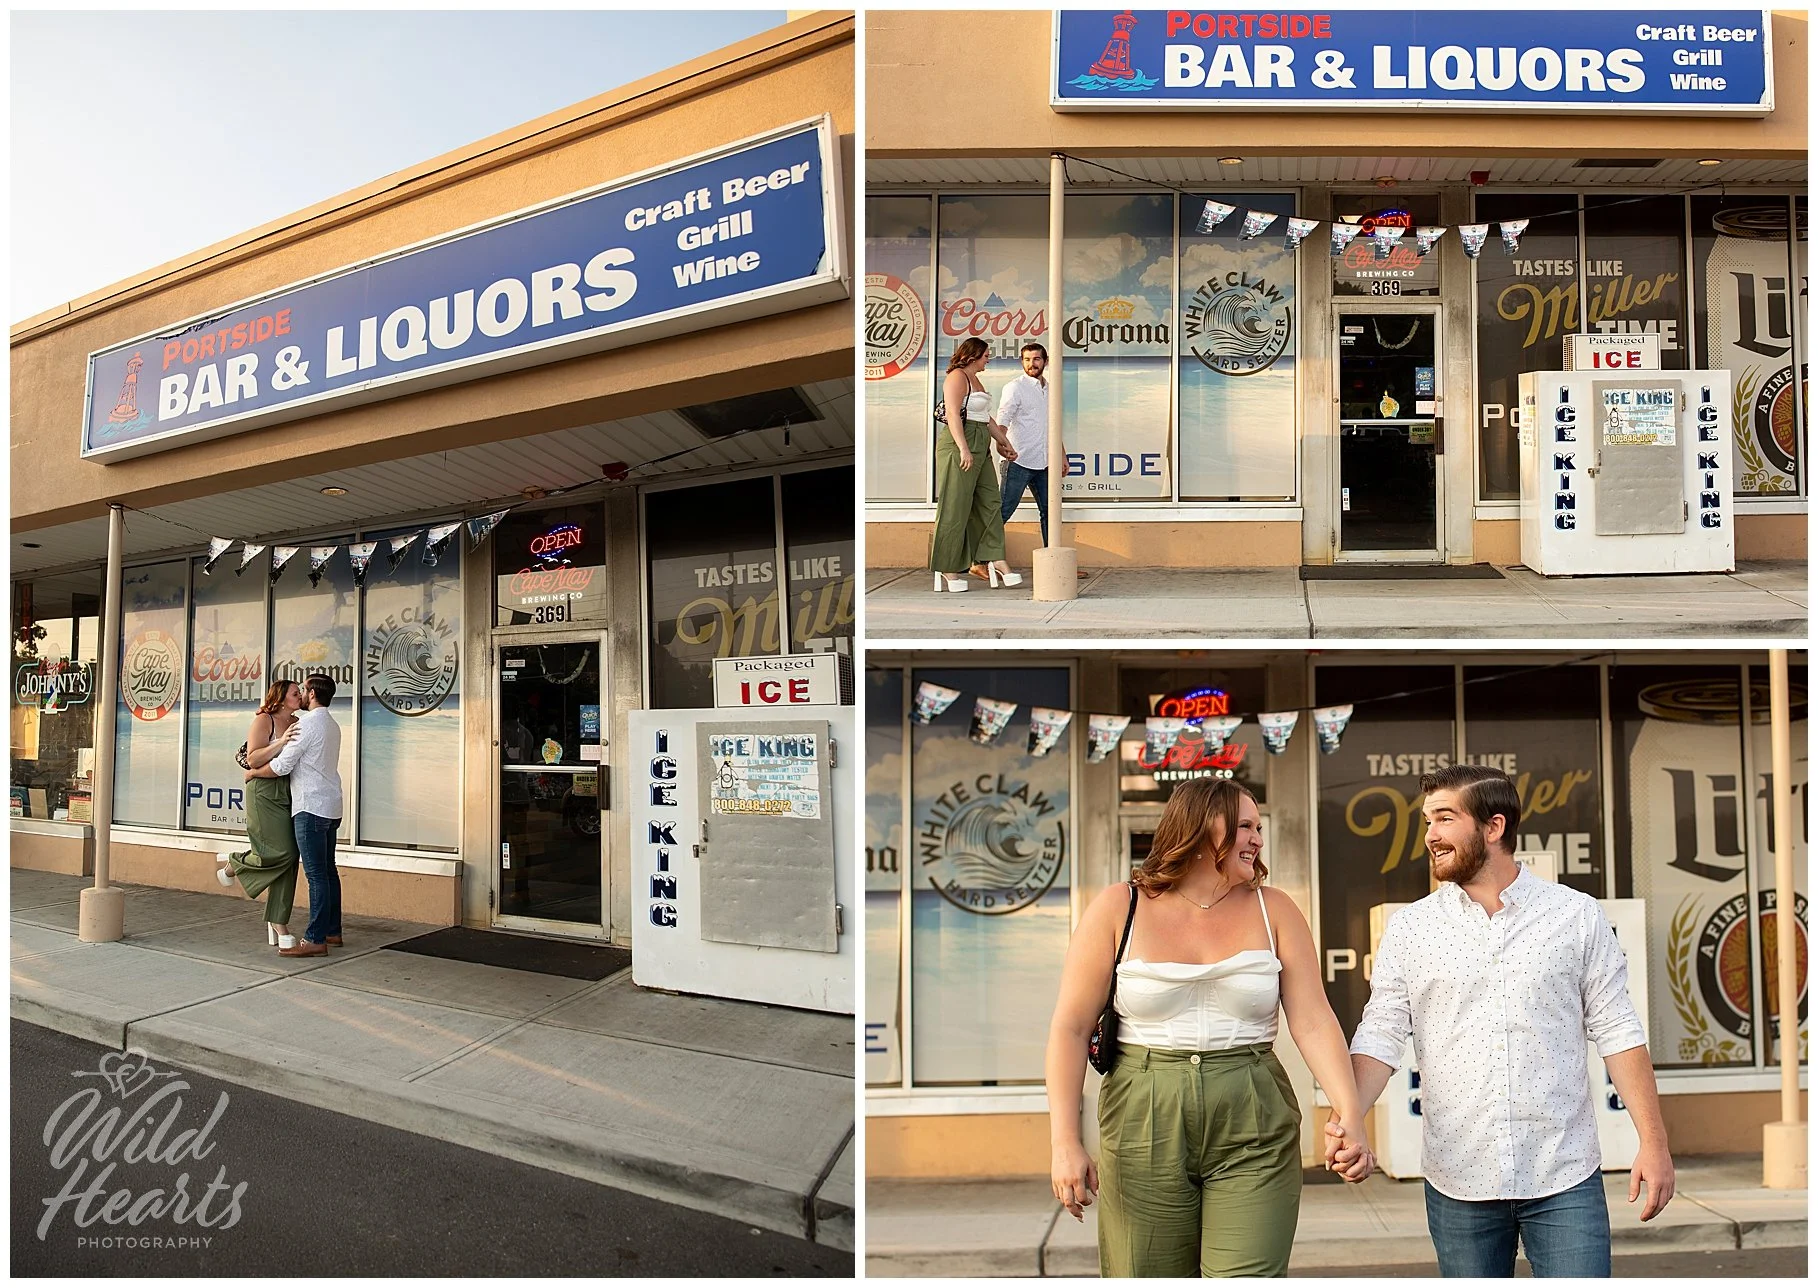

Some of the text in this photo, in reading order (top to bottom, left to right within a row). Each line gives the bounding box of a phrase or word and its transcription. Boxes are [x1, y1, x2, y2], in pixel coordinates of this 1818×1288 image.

[1166, 10, 1332, 39] PORTSIDE
[1635, 23, 1757, 43] Craft Beer
[1164, 44, 1646, 93] BAR & LIQUORS
[1672, 49, 1723, 67] Grill
[1670, 73, 1727, 92] Wine
[625, 160, 810, 232] Craft Beer
[677, 210, 754, 252] Grill
[672, 251, 761, 289] Wine
[1356, 270, 1399, 278] BREWING
[1513, 259, 1624, 276] TASTES LIKE
[1371, 280, 1401, 296] 369
[865, 294, 906, 324] ape
[941, 298, 1049, 337] Coors
[1185, 272, 1285, 340] WHITE CLAW
[1497, 271, 1679, 349] Miller
[158, 247, 639, 422] BAR & LIQUORS
[162, 308, 292, 371] PORTSIDE
[1062, 316, 1170, 352] Corona
[1203, 317, 1286, 371] HARD SELTZER
[1588, 336, 1646, 346] Packaged
[1592, 350, 1643, 369] ICE
[1604, 390, 1673, 406] ICE KING
[1759, 369, 1793, 414] A FINE
[1555, 385, 1577, 442] ICE
[1697, 385, 1719, 442] ICE
[1553, 452, 1577, 530] KING
[1697, 451, 1722, 528] KING
[530, 528, 582, 554] OPEN
[511, 565, 595, 595] Cape May
[694, 556, 842, 588] TASTES LIKE
[522, 592, 583, 605] BREWING CO
[535, 605, 565, 623] 369
[366, 606, 454, 680] WHITE CLAW
[133, 647, 171, 673] Cape
[192, 646, 263, 683] Coors
[734, 659, 816, 672] Packaged
[131, 670, 172, 695] May
[199, 682, 256, 702] LIGHT
[380, 653, 454, 711] HARD SELTZER
[741, 676, 811, 704] ICE
[1161, 694, 1229, 717] OPEN
[712, 735, 815, 757] ICE KING
[649, 729, 678, 806] ICE
[1215, 769, 1234, 779] CO
[1366, 753, 1450, 776] TASTES
[921, 773, 1055, 866] WHITE CLAW
[648, 820, 679, 928] KING
[945, 836, 1058, 908] HARD SELTZER
[1701, 897, 1748, 959] A FINE
